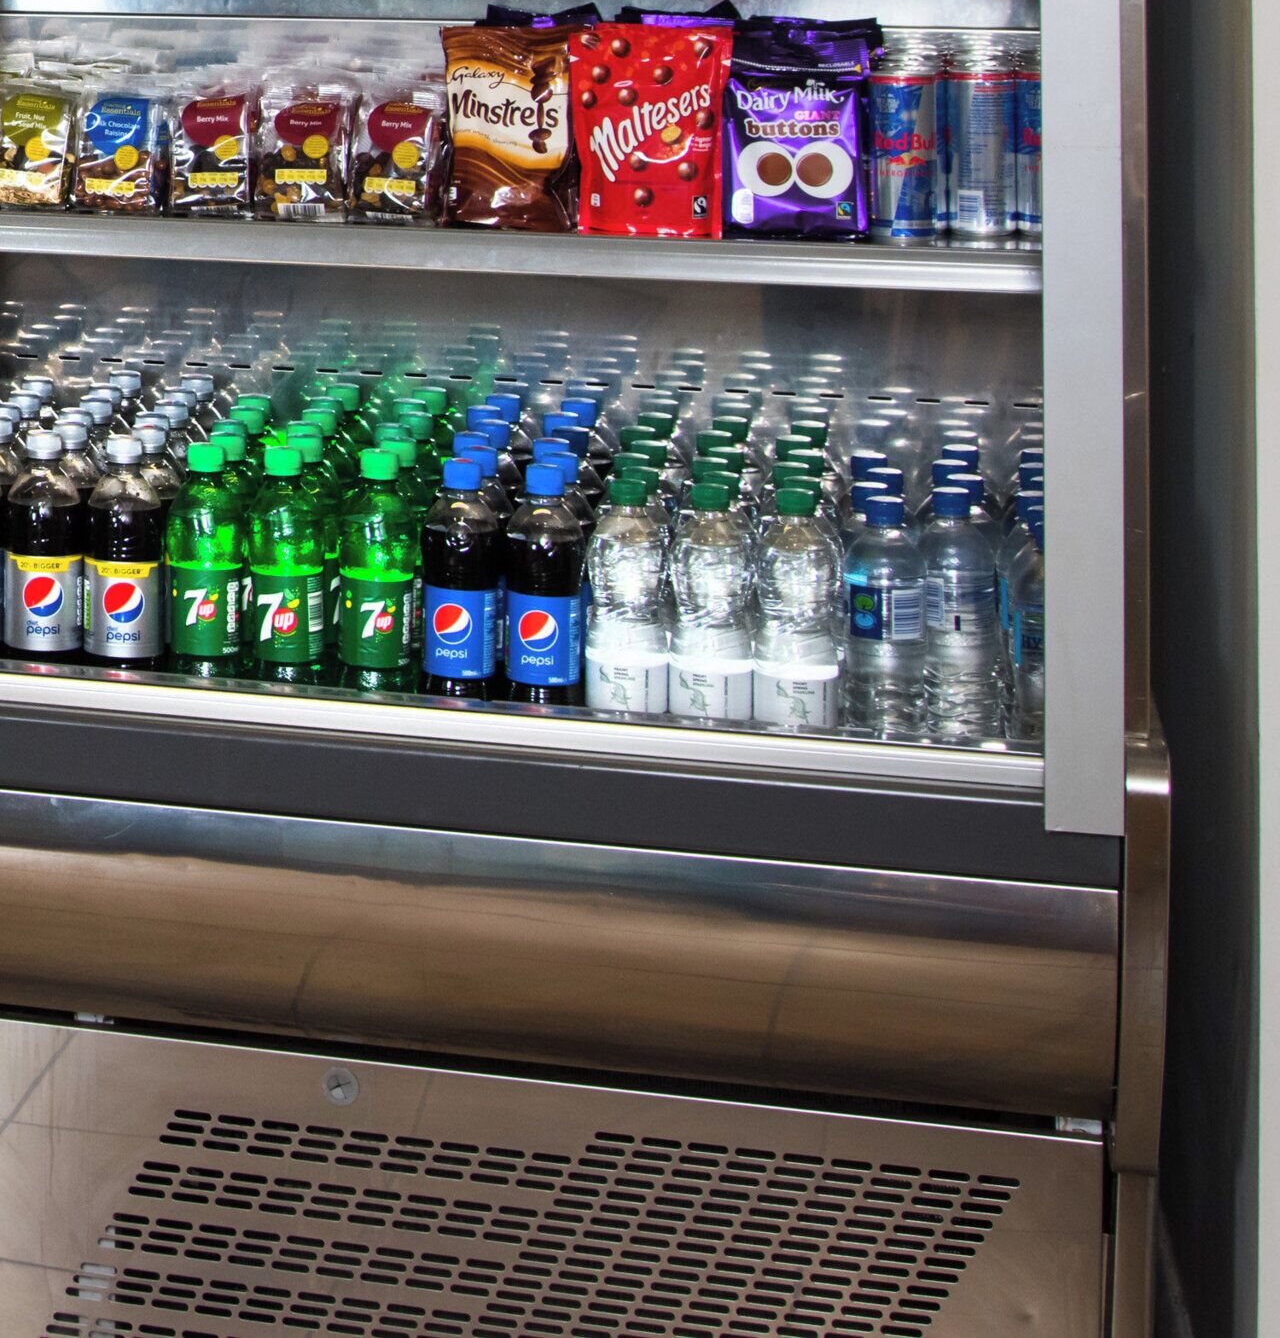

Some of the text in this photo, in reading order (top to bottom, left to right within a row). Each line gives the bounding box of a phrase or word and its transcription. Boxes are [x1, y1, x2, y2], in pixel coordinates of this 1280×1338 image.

[451, 66, 505, 89] Galaxy
[736, 85, 844, 114] Dairy Milk
[452, 89, 559, 128] Minstrels
[196, 116, 215, 124] Berry
[793, 110, 840, 121] GIANT
[290, 119, 309, 127] Berry
[381, 120, 400, 128] Berry
[744, 118, 841, 138] buttons
[589, 84, 711, 182] Maltesers
[873, 130, 908, 150] Red
[26, 624, 60, 636] pepsi
[106, 630, 141, 643] pepsi
[435, 647, 468, 660] pepsi
[521, 655, 554, 666] pepsi
